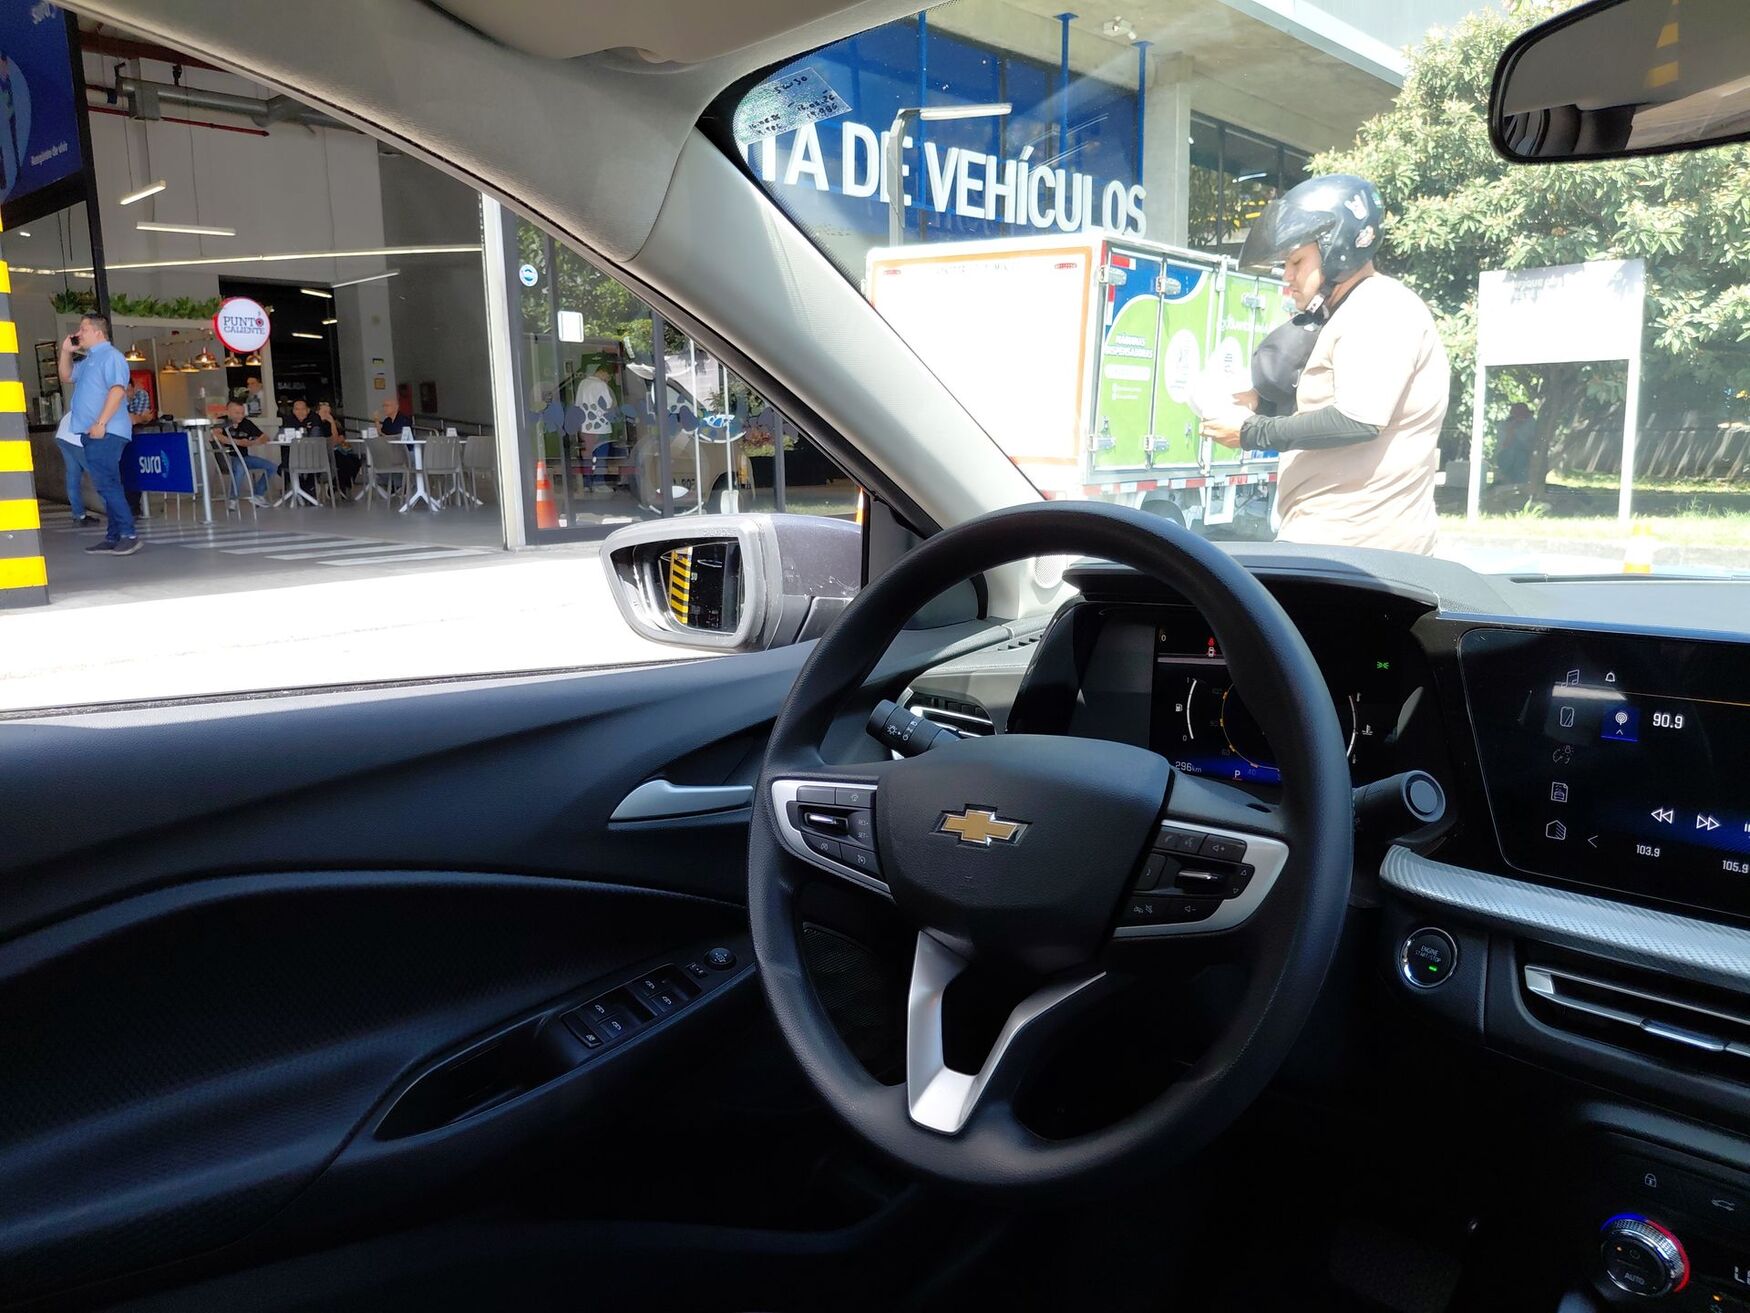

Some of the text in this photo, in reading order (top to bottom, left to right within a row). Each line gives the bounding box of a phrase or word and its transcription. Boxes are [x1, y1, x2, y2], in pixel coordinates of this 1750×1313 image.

[842, 121, 914, 207] DE
[923, 144, 1148, 239] VEHÍCULOS
[138, 455, 162, 474] sura
[1652, 712, 1684, 729] 90.9
[1636, 844, 1660, 857] 103.9
[1722, 859, 1749, 874] 105.9
[1624, 1272, 1645, 1285] AUTO
